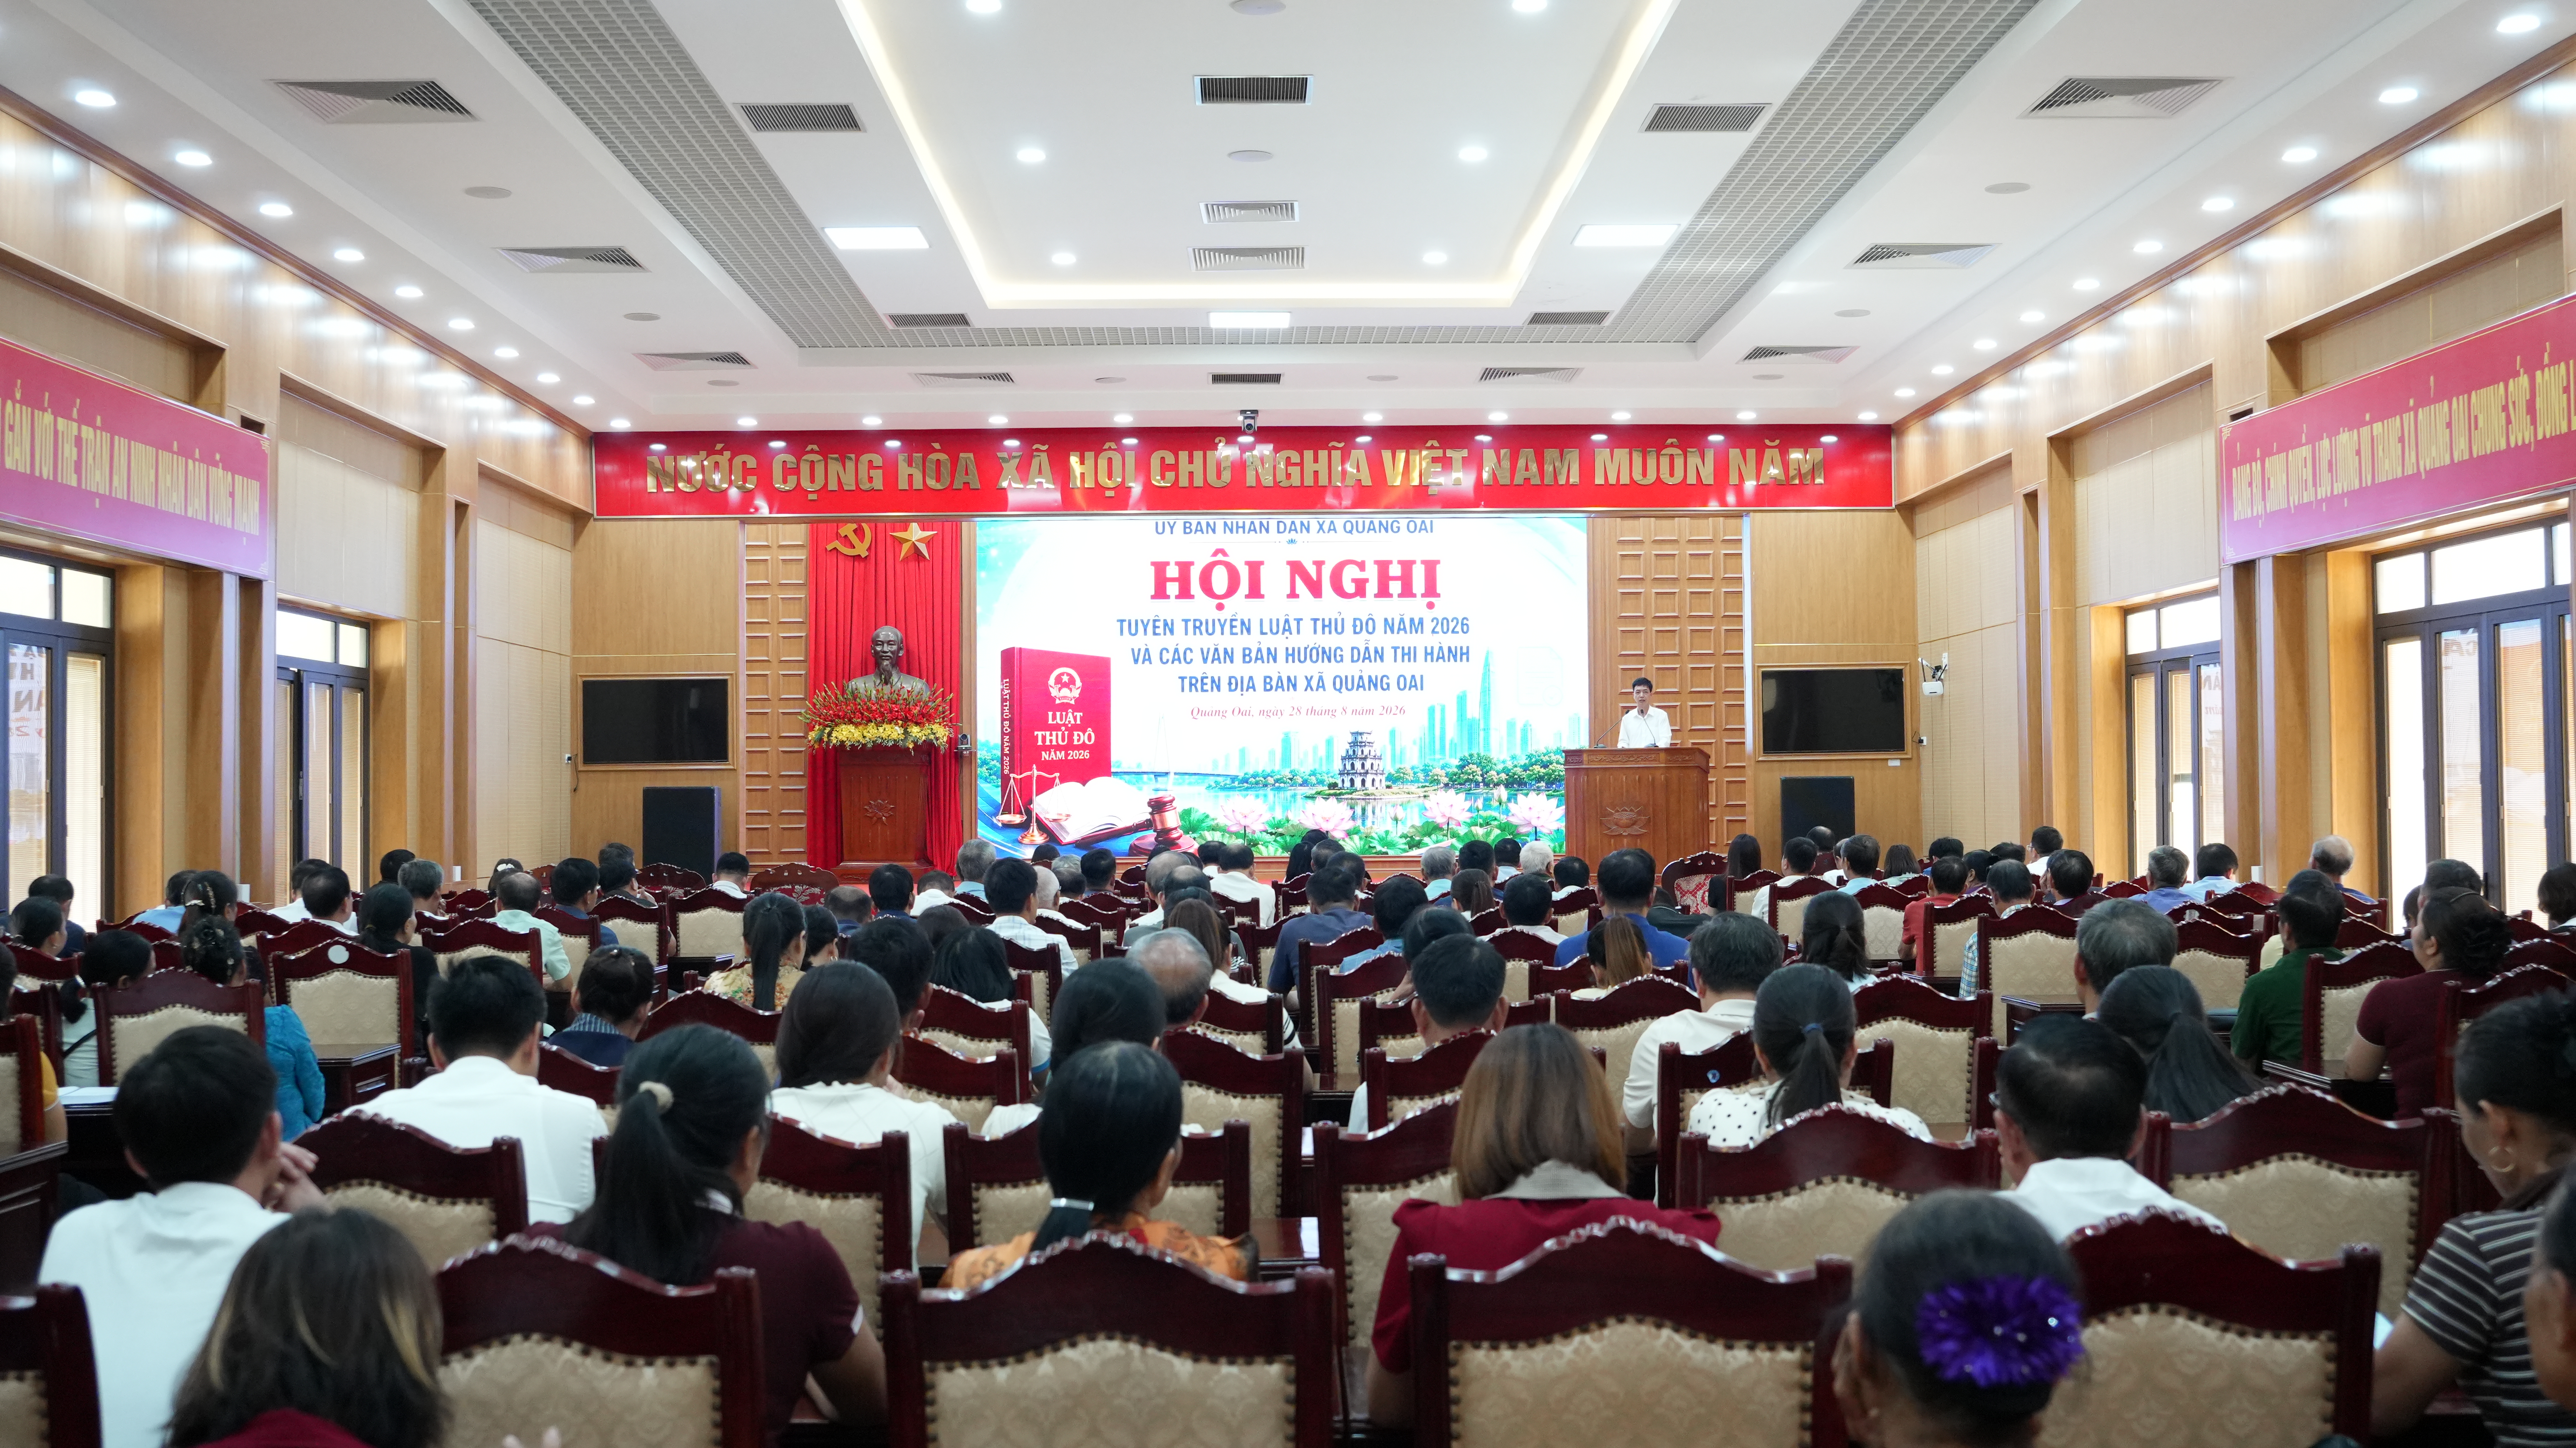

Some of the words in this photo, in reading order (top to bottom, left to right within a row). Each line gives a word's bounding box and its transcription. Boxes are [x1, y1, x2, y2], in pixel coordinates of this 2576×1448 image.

[2232, 441, 2252, 521] ĐẢNG
[2252, 448, 2264, 528] BỘ,
[2265, 442, 2288, 515] CHÍNH
[2316, 433, 2332, 512] LỰC
[2332, 426, 2360, 507] LƯỢNG
[2360, 412, 2373, 488] VŨ
[2373, 415, 2403, 484] TRANG
[2403, 397, 2418, 476] XÃ
[2418, 375, 2451, 479] QUẢNG
[2452, 393, 2470, 464] OAI
[2471, 381, 2507, 458] CHUNG
[2508, 355, 2535, 452] SỨC,
[5, 379, 32, 474] GẮN
[34, 392, 54, 481] VỚI
[57, 398, 80, 487] THẾ
[81, 415, 111, 508] TRẬN
[112, 435, 128, 501] AN
[130, 440, 156, 508] NINH
[158, 441, 186, 516] NHÂN
[187, 448, 208, 522] DÂN
[209, 452, 233, 529] VỮNG
[234, 474, 260, 546] MẠNH
[647, 444, 757, 493] NƯỚC
[773, 444, 883, 500] CỘNG
[899, 443, 980, 490] HÒA
[996, 444, 1055, 489] XÃ
[1069, 442, 1135, 497] HỘI
[1150, 436, 1231, 488] CHỦ
[1246, 441, 1372, 488] NGHĨA
[1382, 440, 1468, 496] VIỆT
[1482, 448, 1580, 486] NAM
[1594, 439, 1714, 486] MUÔN
[1728, 439, 1824, 485] NĂM
[1407, 520, 1433, 533] OAI
[1150, 548, 1265, 611] HỘI
[1286, 559, 1441, 610] NGHỊ
[1117, 615, 1174, 636] TUYÊN
[1181, 612, 1251, 636] TRUYỀN
[1259, 614, 1303, 639] LUẬT
[1310, 611, 1345, 635] THỦ
[1352, 613, 1376, 635] ĐÔ
[1384, 613, 1424, 635] NĂM
[1431, 617, 1470, 635] 2026
[1131, 642, 1152, 664] VÀ
[1159, 642, 1193, 664] CÁC
[1200, 642, 1234, 664] VĂN
[1242, 641, 1278, 664] BẢN
[1285, 642, 1344, 664] HƯỚNG
[1351, 639, 1385, 663] DẪN
[1391, 645, 1417, 662] THI
[1424, 642, 1470, 662] HÀNH
[1002, 678, 1011, 699] LUẬT
[1178, 672, 1221, 692] TRÊN
[1227, 675, 1256, 696] ĐỊA
[1263, 671, 1297, 692] BÀN
[1304, 671, 1326, 692] XÃ
[1333, 669, 1390, 693] QUẢNG
[1396, 674, 1424, 691] OAI
[1003, 701, 1011, 719] THỦ
[1048, 709, 1083, 727] LUẬT
[1191, 707, 1228, 720] Quảng
[1231, 706, 1254, 718] Oai,
[1258, 706, 1285, 719] ngày
[1288, 706, 1302, 716] 28
[1305, 706, 1337, 719] tháng
[1341, 705, 1347, 716] 8
[1351, 707, 1375, 716] năm
[1378, 705, 1406, 716] 2026
[1003, 720, 1011, 733] ĐÔ
[1034, 726, 1069, 746] THỦ
[1073, 727, 1095, 745] ĐÔ
[1041, 749, 1065, 761] NĂM
[1067, 750, 1090, 759] 2026
